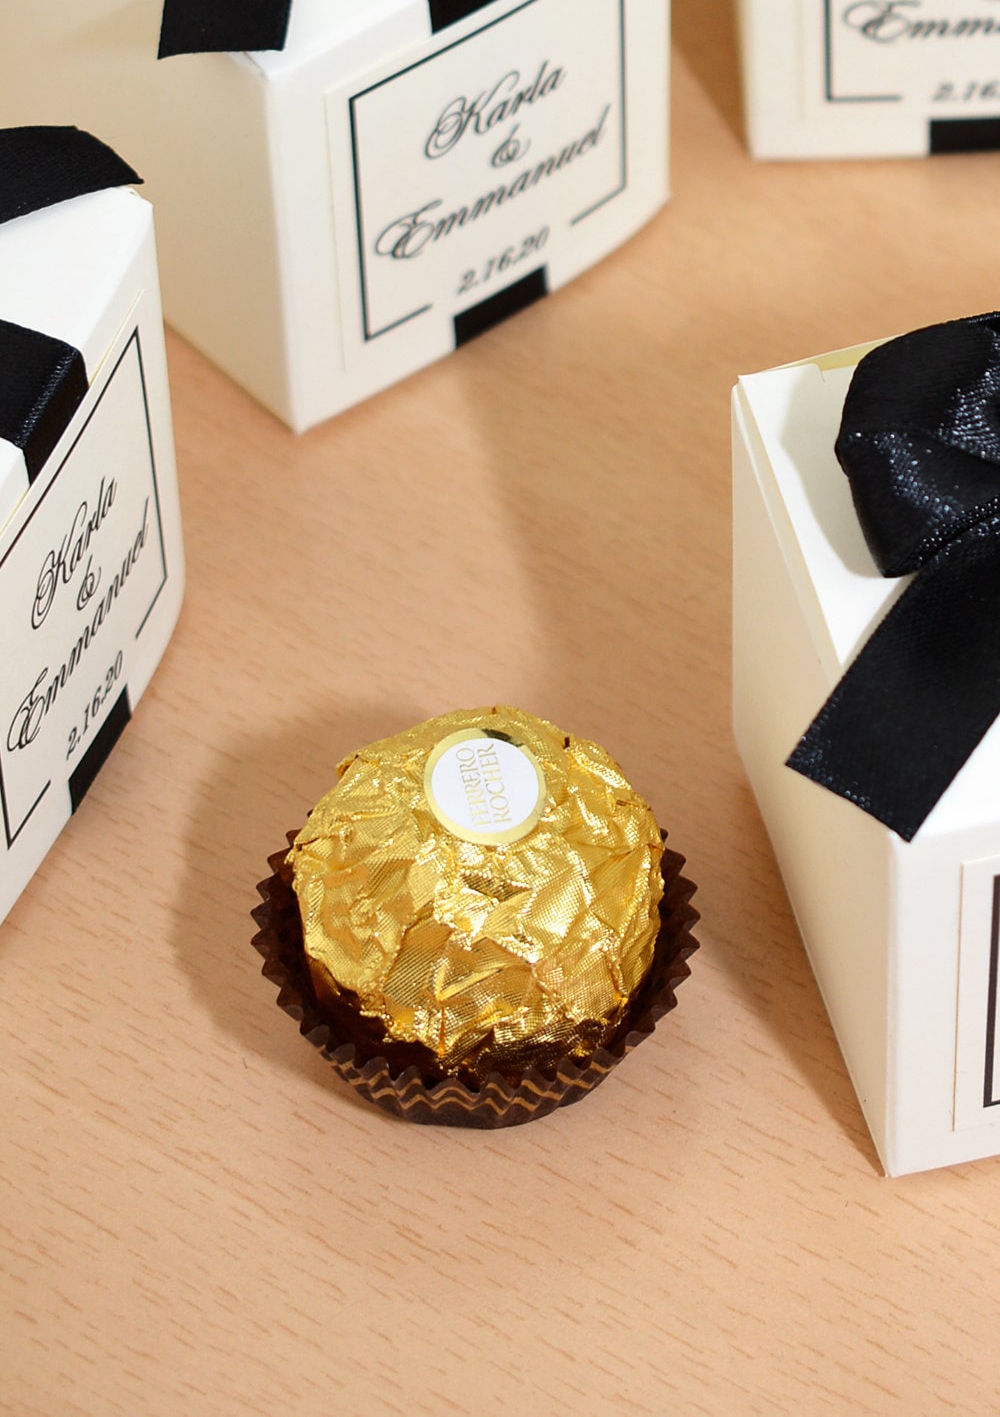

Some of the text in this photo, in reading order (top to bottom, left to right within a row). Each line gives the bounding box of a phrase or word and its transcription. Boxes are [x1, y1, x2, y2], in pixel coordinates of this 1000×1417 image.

[424, 60, 568, 160] Karla
[490, 123, 531, 169] &
[375, 104, 611, 259] Emmanuel
[31, 475, 118, 631] Karla
[76, 553, 101, 611] &
[8, 496, 150, 753] Emmanuel
[66, 650, 123, 761] 2.16.20
[456, 747, 492, 827] FERRERO
[477, 743, 512, 823] ROCHER
